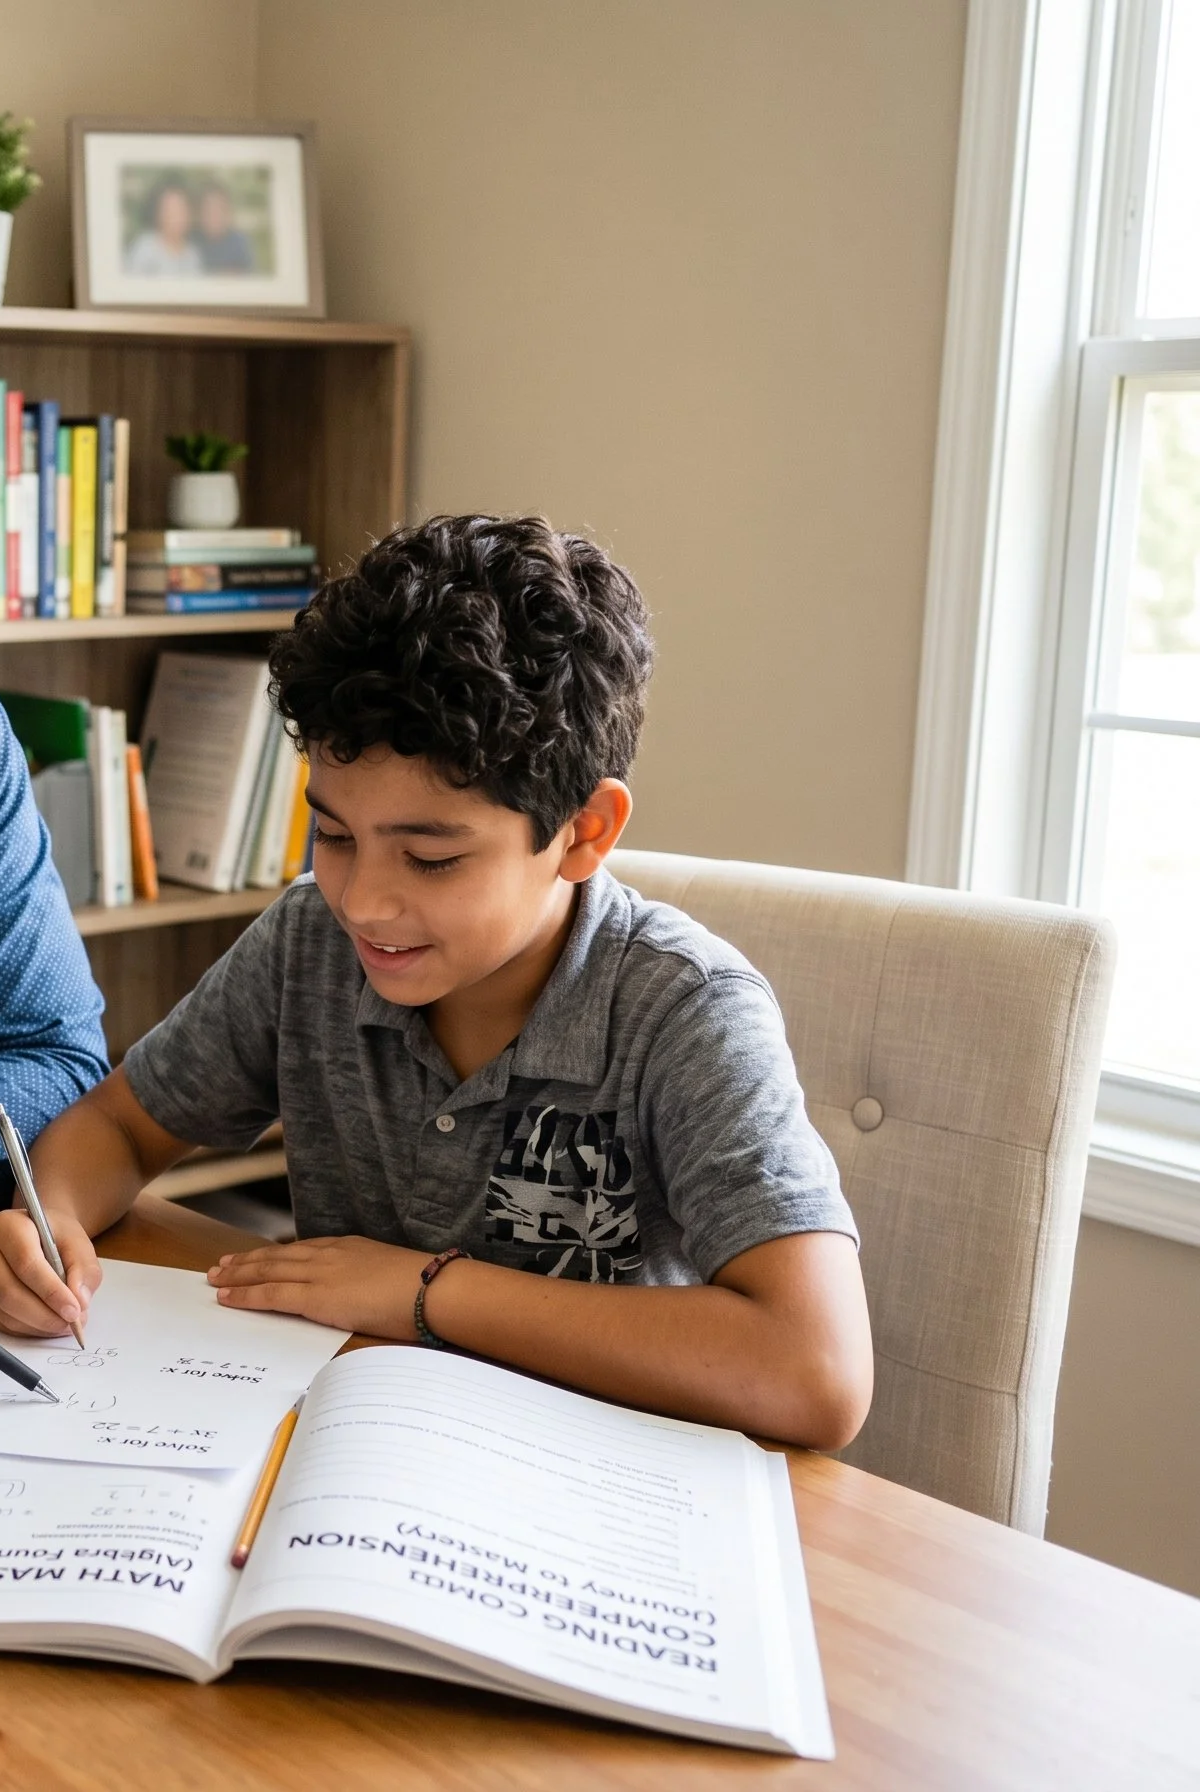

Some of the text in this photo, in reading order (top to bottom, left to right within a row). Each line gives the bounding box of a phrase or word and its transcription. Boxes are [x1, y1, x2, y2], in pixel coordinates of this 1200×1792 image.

[92, 1422, 120, 1430] 22
[146, 1426, 159, 1434] 7
[190, 1430, 218, 1439] 3x
[119, 1439, 148, 1448] for
[155, 1442, 211, 1453] Solve
[395, 1522, 528, 1575] Mastery)
[74, 1548, 193, 1572] (Algebra
[77, 1568, 184, 1594] MATH
[539, 1569, 569, 1588] to
[581, 1579, 716, 1627] (Journey
[543, 1612, 719, 1674] READING
